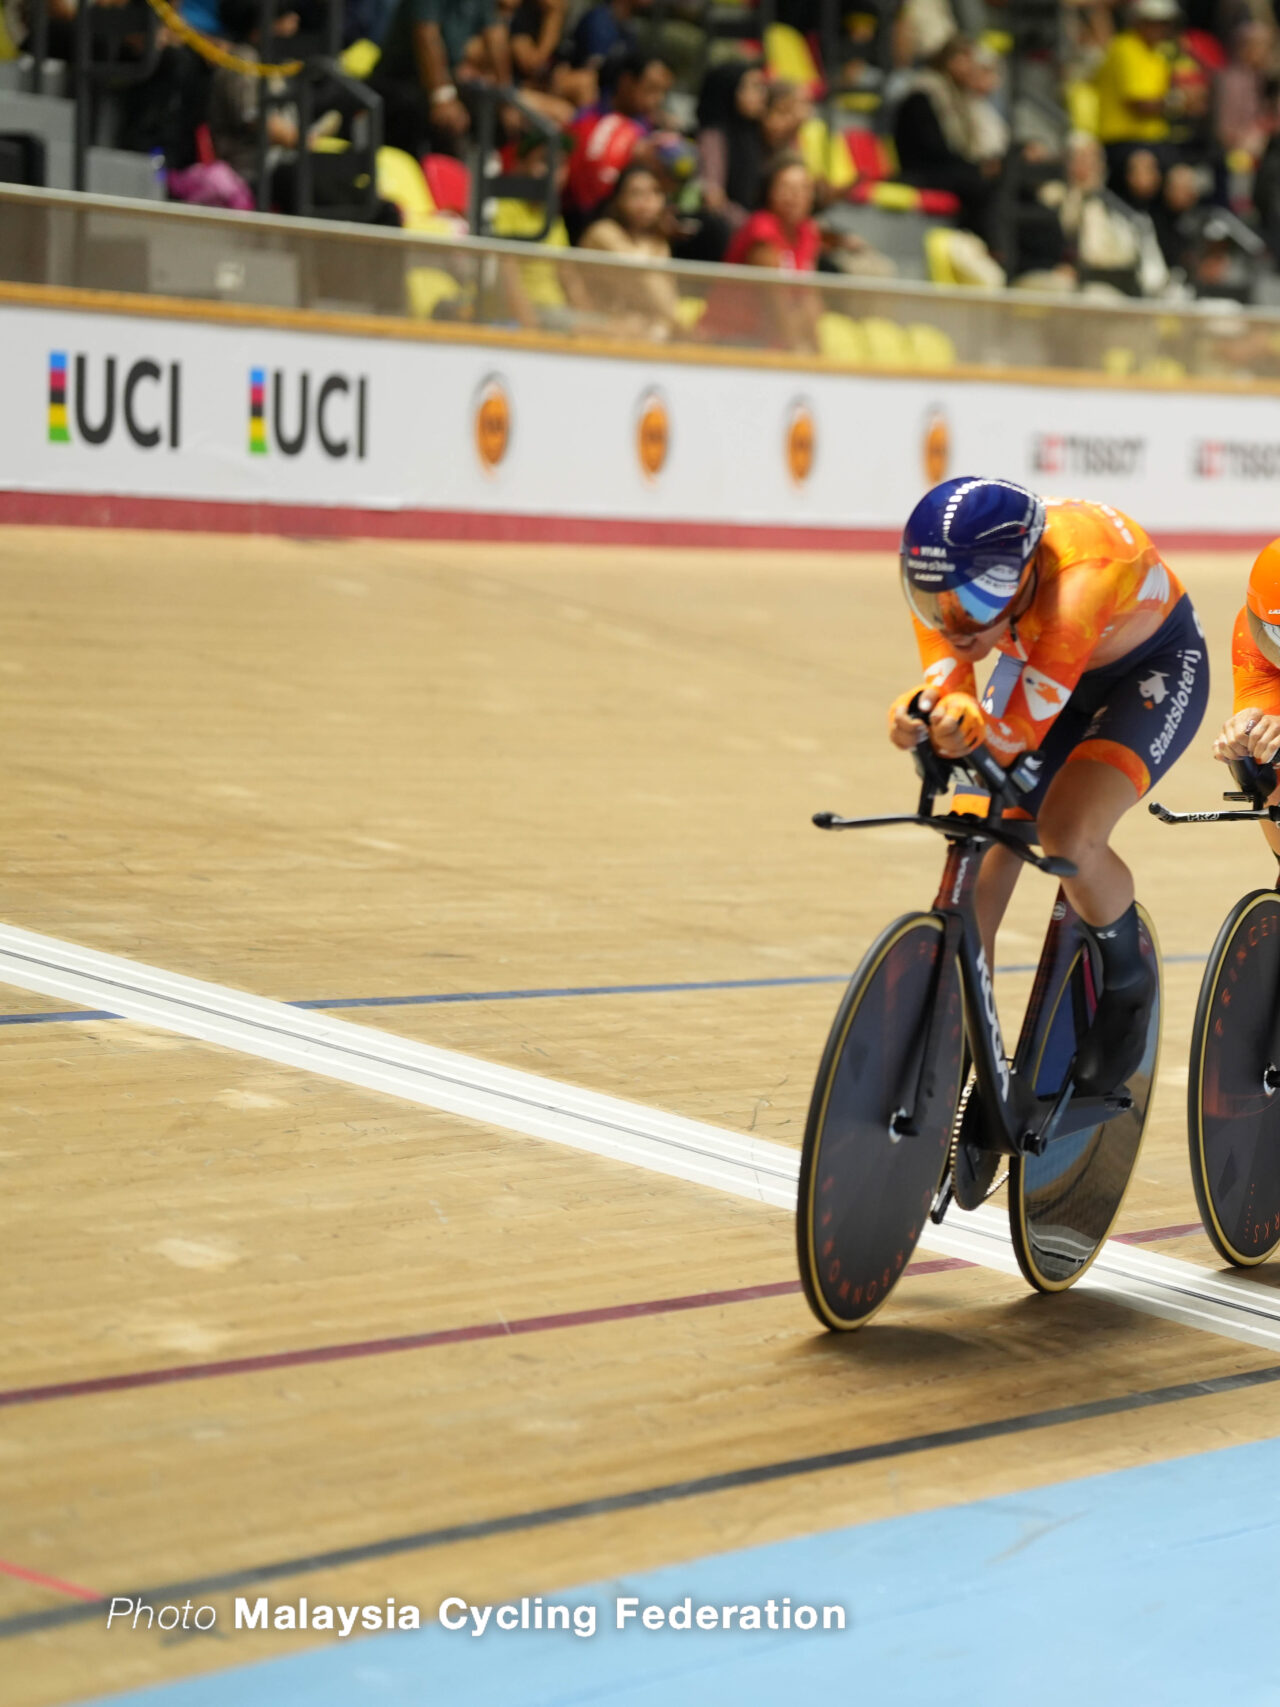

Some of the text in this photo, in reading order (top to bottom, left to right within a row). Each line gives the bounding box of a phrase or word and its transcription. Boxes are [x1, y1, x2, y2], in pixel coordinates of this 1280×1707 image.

[74, 354, 181, 450] UCI
[272, 366, 368, 460] UCI
[1149, 648, 1202, 765] Staatsloterij
